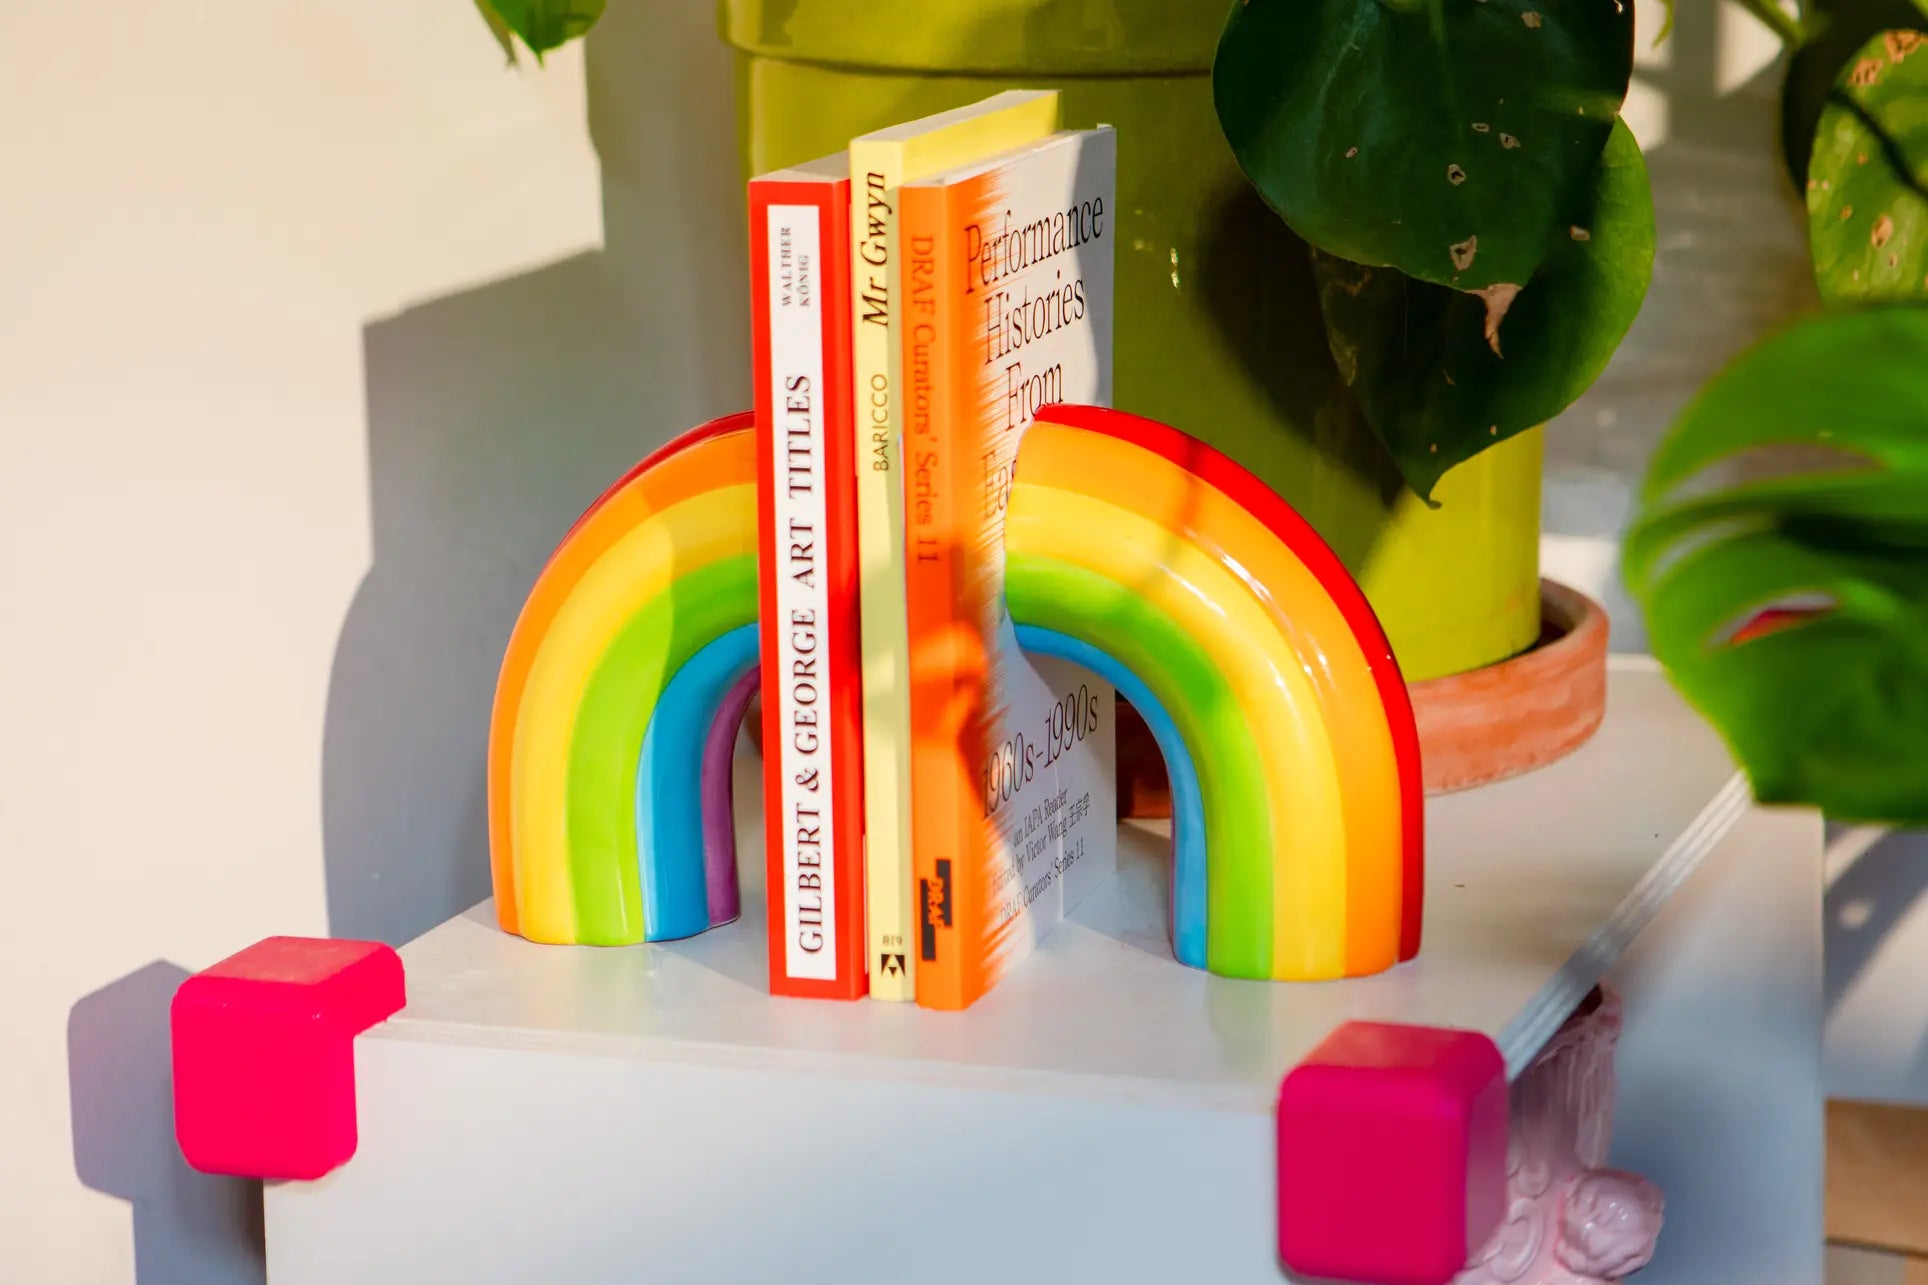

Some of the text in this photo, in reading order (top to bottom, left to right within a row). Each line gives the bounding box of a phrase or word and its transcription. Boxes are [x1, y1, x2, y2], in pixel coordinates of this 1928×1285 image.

[780, 226, 791, 307] WALTHER
[797, 254, 811, 308] KÖNIG
[860, 171, 892, 328] Mr Gwyn
[911, 234, 936, 317] DRAF
[963, 196, 1105, 295] Performance
[984, 269, 1086, 366] Histories
[871, 374, 889, 472] BARICCO
[1005, 361, 1064, 432] From
[915, 451, 939, 527] Series
[981, 449, 1017, 518] Ea
[917, 536, 939, 564] 11
[786, 375, 824, 954] GILBERT & GEORGE ART TITLES
[1013, 788, 1068, 848] an IAPA Reader
[1015, 852, 1025, 877] by
[1025, 833, 1049, 863] Victor
[1047, 818, 1068, 843] Wang
[1054, 849, 1075, 879] Series
[1075, 836, 1085, 861] 11
